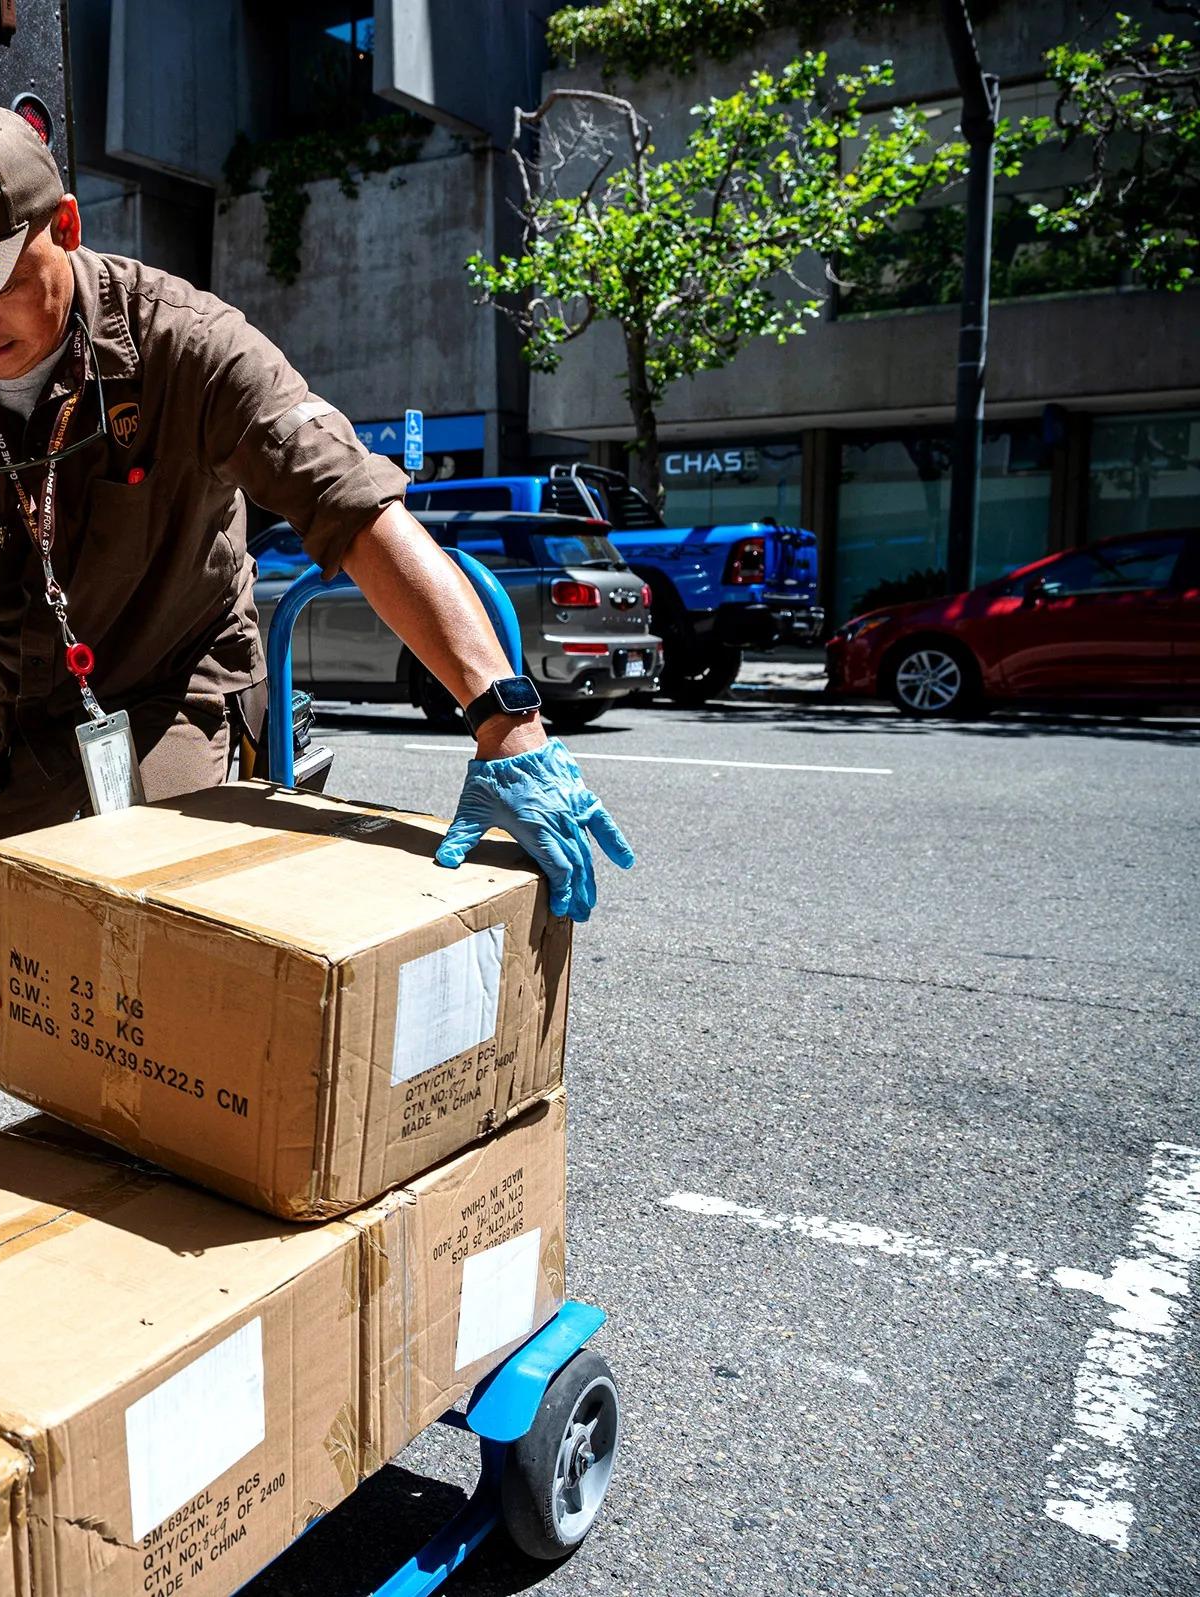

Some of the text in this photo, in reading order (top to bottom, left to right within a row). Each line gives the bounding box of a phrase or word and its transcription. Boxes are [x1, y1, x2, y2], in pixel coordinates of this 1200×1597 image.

[113, 415, 138, 442] ups
[665, 451, 759, 474] CHASE
[43, 514, 52, 531] FOR
[44, 496, 52, 513] ON
[9, 947, 144, 1019] N.W.: 2.3 KG
[9, 977, 145, 1047] G.W.: 3.2 KG
[9, 1001, 249, 1118] MEAS: 39.5X39.5X22.5 CM
[405, 1067, 457, 1102] Q'TY/CTN:
[461, 1057, 472, 1074] 25
[477, 1044, 496, 1065] PCS
[401, 1086, 481, 1139] MADE IN CHINA
[403, 1098, 425, 1120] CTN
[430, 1089, 448, 1107] NO:
[475, 1064, 490, 1082] OF
[461, 1167, 524, 1221] MADE IN CHINA
[491, 1198, 505, 1215] NO:
[508, 1184, 524, 1204] CTN
[433, 1236, 452, 1261] 2400
[452, 1200, 524, 1265] Q'TY/CTN: 25 PCS
[457, 1225, 468, 1243] OF
[143, 1491, 213, 1550] SM-6924CL
[143, 1473, 260, 1571] Q'TY/CTN: 25 PCS
[144, 1561, 171, 1591] CTN
[179, 1541, 202, 1567] NO:
[237, 1498, 253, 1520] OF
[260, 1472, 285, 1503] 2400
[191, 1557, 203, 1577] IN
[210, 1524, 247, 1561] CHINA
